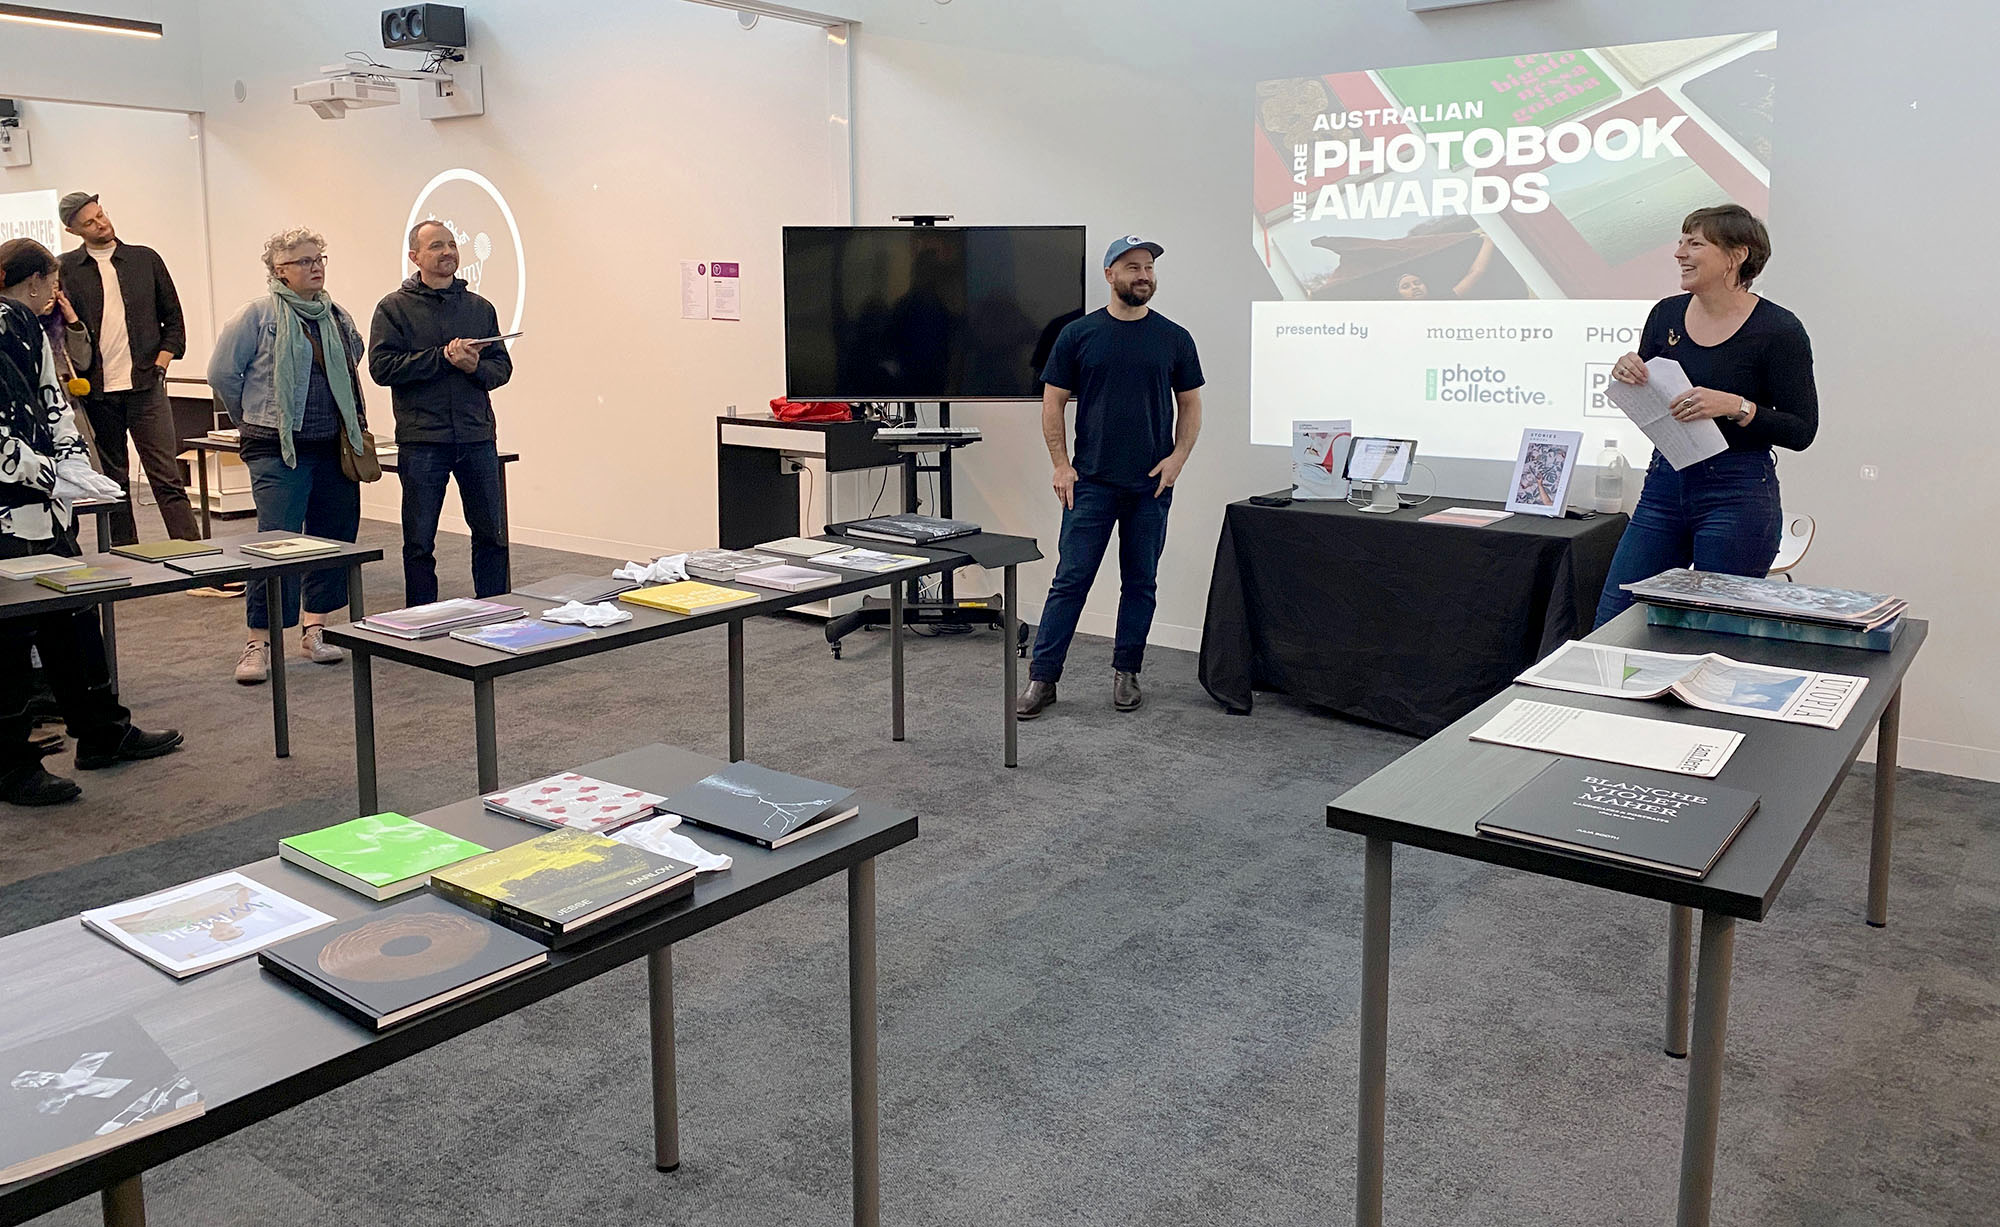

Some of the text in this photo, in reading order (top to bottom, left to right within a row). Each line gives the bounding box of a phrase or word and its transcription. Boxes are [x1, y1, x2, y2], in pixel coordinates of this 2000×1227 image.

[1313, 101, 1483, 131] AUSTRALIAN
[1314, 115, 1689, 177] PHOTOBOOK
[1293, 143, 1308, 223] WE ARE
[1310, 172, 1551, 222] AWARDS
[1276, 322, 1368, 339] presented by
[1441, 363, 1506, 386] photo
[1793, 679, 1853, 718] UTOPIA
[1581, 776, 1709, 805] BLANCHE
[1590, 785, 1690, 809] VIOLET
[1578, 792, 1678, 817] MAHER
[626, 863, 675, 887] MARLOW
[556, 898, 593, 917] JESSE
